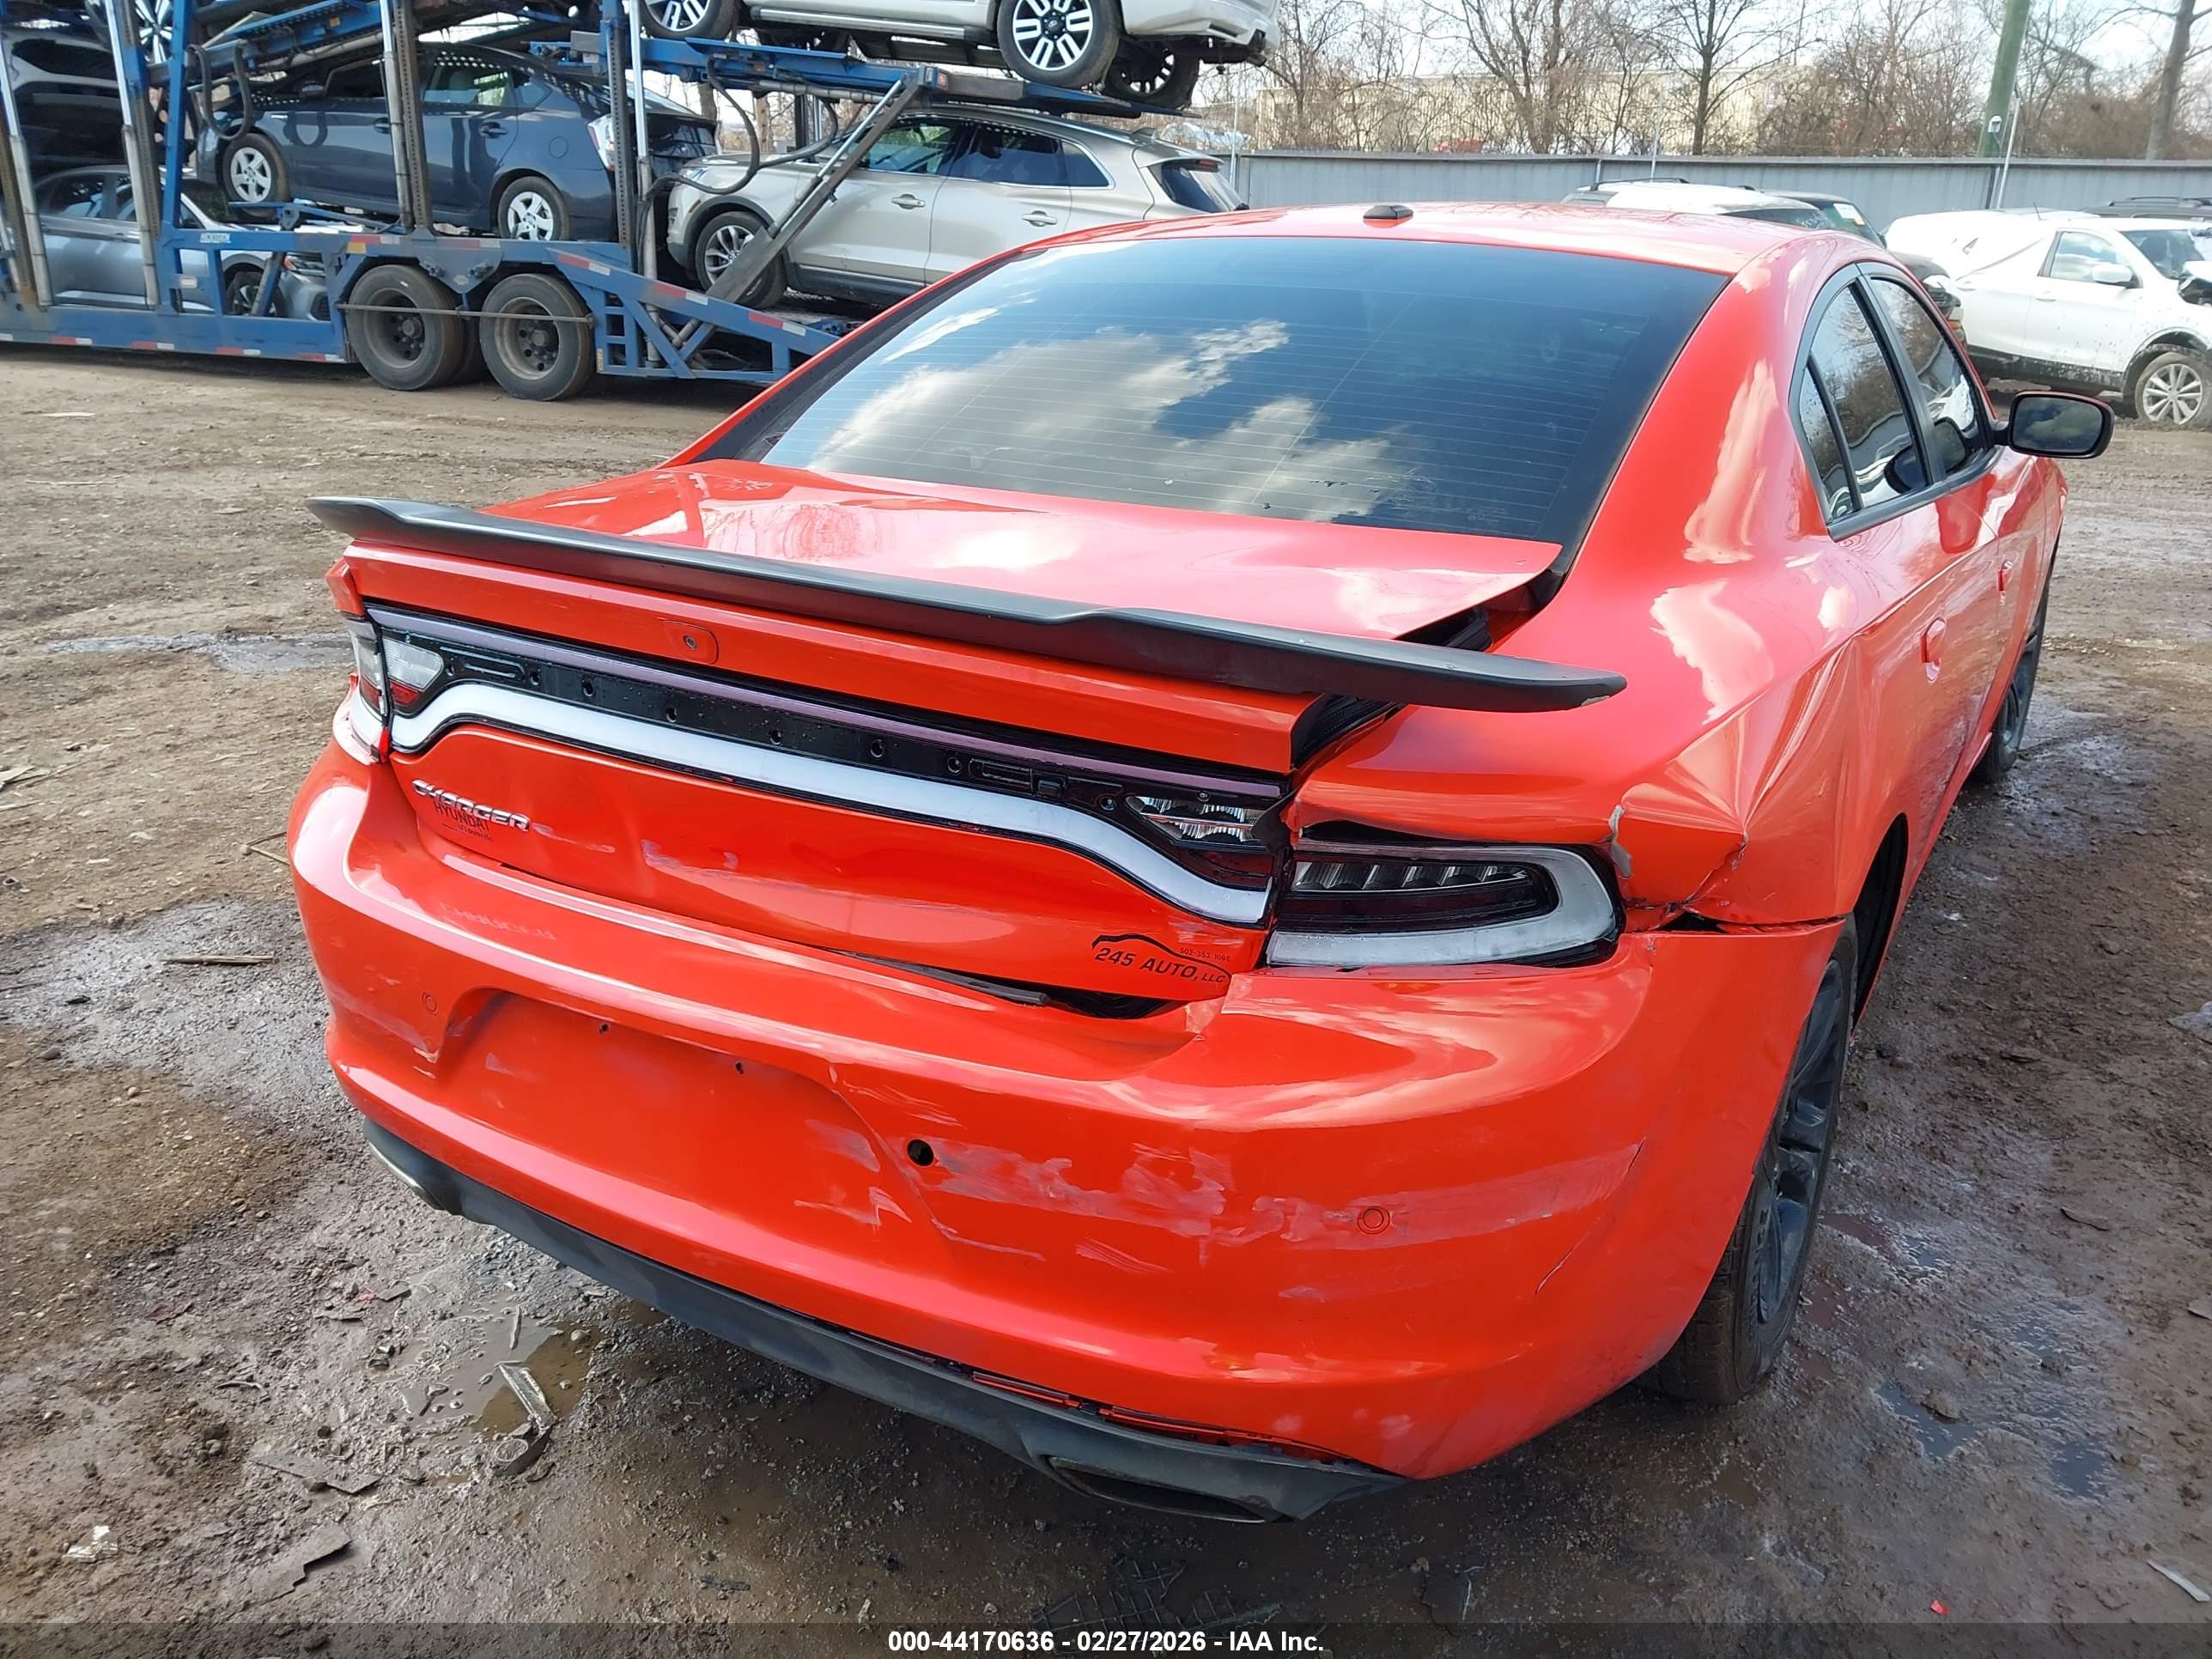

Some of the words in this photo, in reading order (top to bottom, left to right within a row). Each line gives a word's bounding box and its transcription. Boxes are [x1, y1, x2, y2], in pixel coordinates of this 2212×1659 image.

[412, 779, 530, 832] CHARGER
[434, 801, 490, 832] HYUNDAI
[1095, 947, 1137, 967] 245
[1140, 957, 1199, 981] AUTO,
[1201, 972, 1226, 983] LLC
